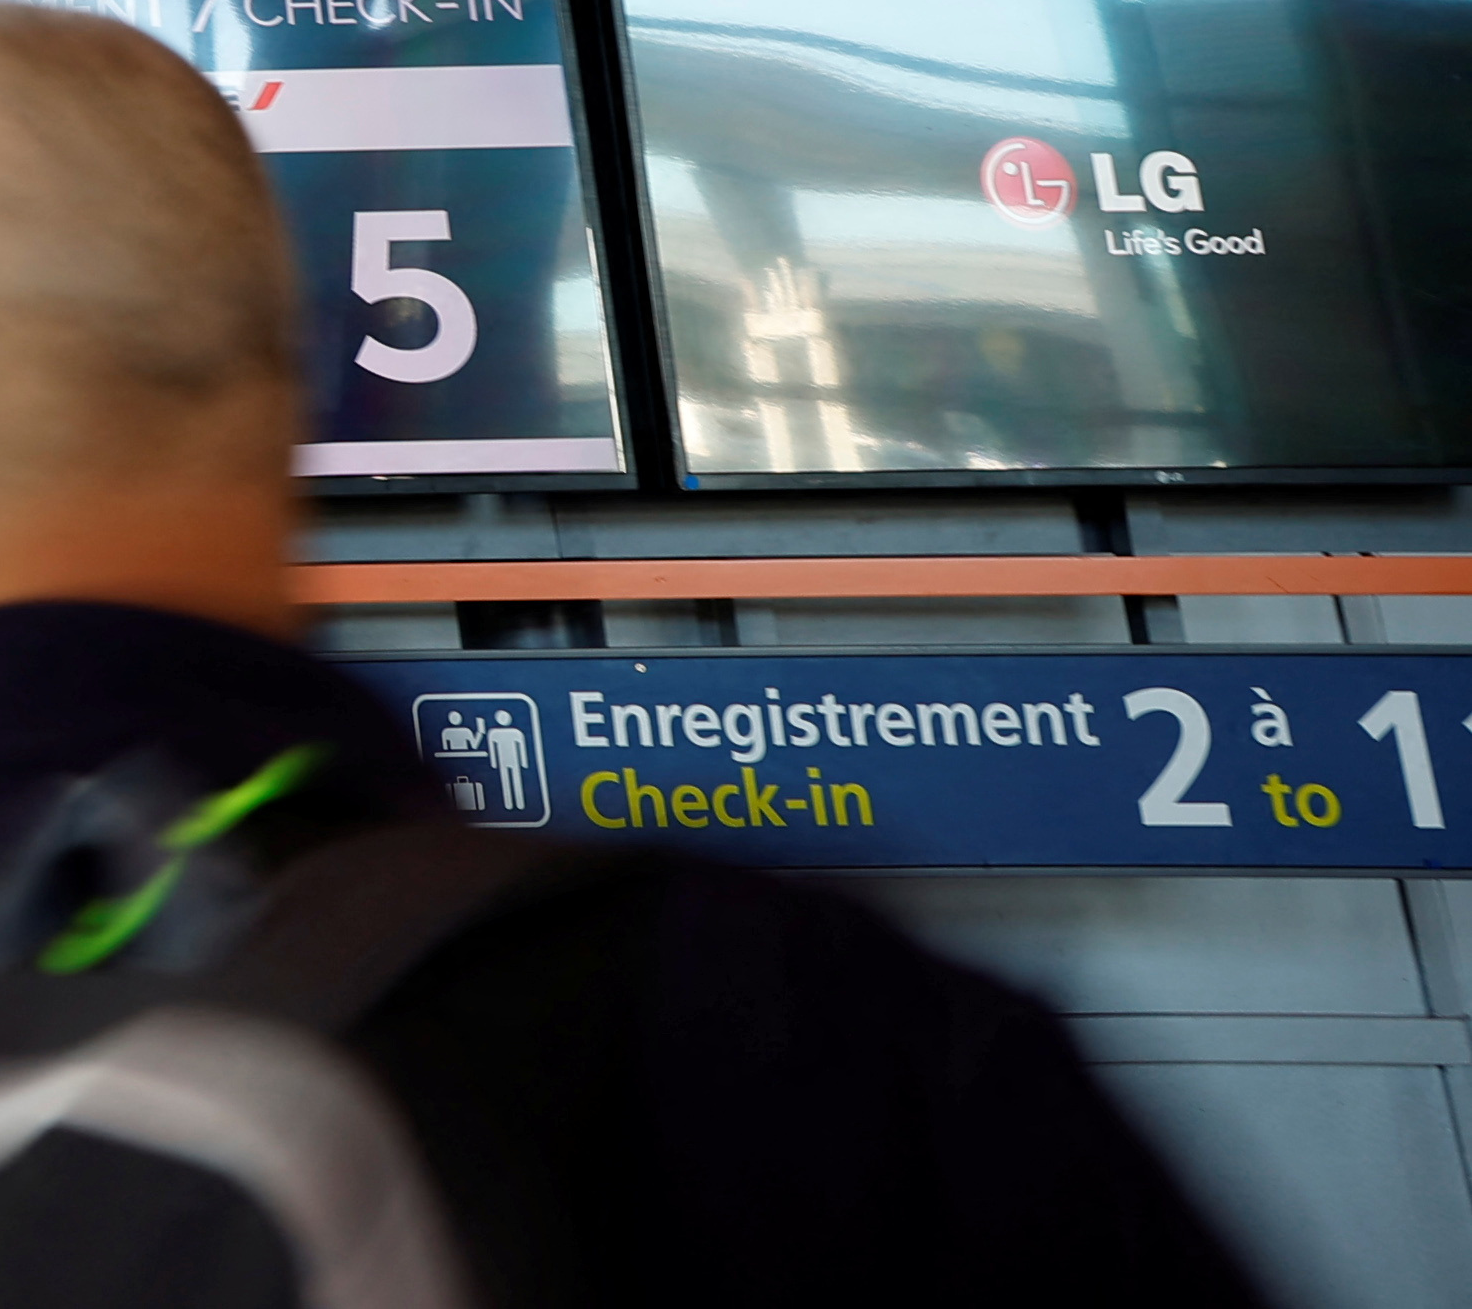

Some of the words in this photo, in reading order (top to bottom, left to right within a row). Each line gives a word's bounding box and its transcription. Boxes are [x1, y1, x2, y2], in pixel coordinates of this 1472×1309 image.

[1089, 150, 1205, 214] LG
[1104, 228, 1183, 256] Life's
[1183, 227, 1267, 256] Good
[350, 209, 478, 385] 5
[568, 687, 1101, 764] Enregistrement
[1121, 686, 1233, 827] 2
[1250, 686, 1295, 748] à
[1357, 689, 1472, 830] 1
[579, 764, 874, 830] Check-in
[1260, 773, 1342, 829] to
